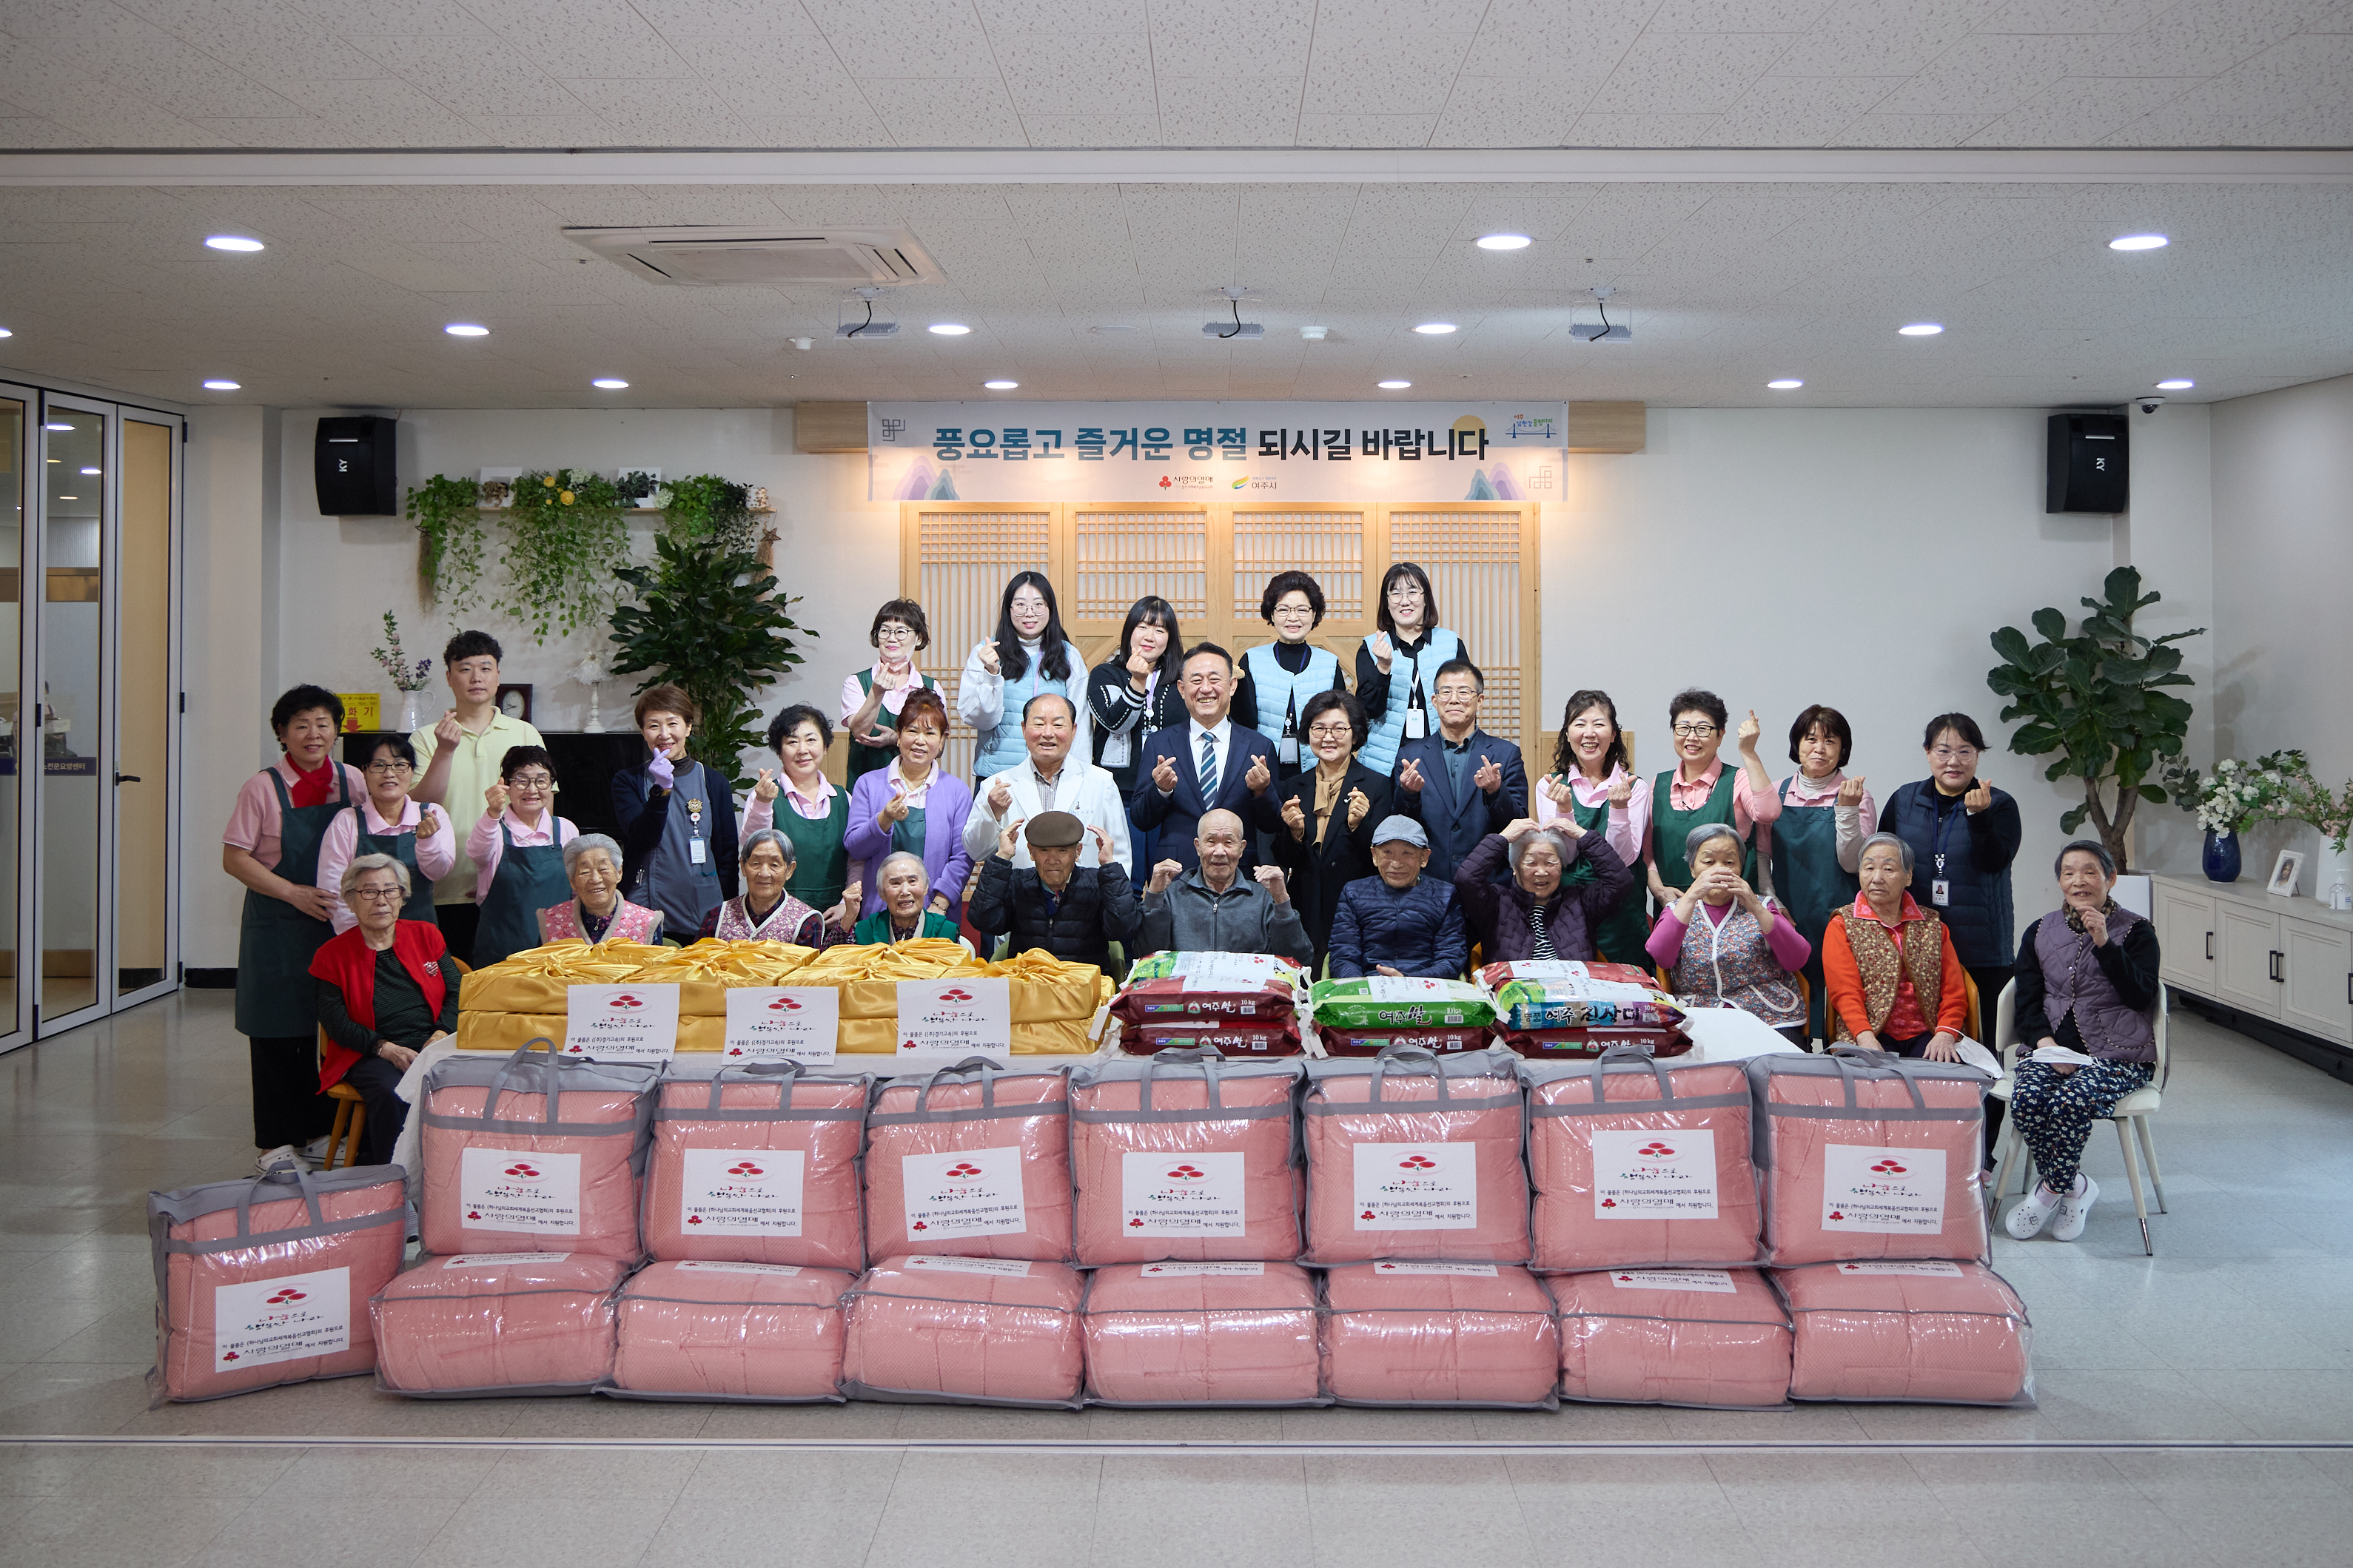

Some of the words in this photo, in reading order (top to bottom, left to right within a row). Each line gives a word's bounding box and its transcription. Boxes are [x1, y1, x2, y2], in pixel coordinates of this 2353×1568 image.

[933, 428, 1064, 460] 풍요롭고
[1075, 428, 1173, 460] 즐거운
[1184, 428, 1246, 461] 명절
[1258, 429, 1351, 461] 되시길
[1362, 429, 1488, 461] 바랍니다
[339, 459, 347, 471] KY
[2096, 458, 2105, 471] KY
[348, 707, 372, 716] 화기
[1202, 1000, 1236, 1013] 여주쌀
[1379, 1004, 1432, 1026] 여주쌀
[1525, 1012, 1540, 1022] 명품
[1545, 1006, 1577, 1026] 여주
[1580, 1006, 1639, 1022] 진상미
[1214, 1036, 1247, 1048] 여주쌀
[1409, 1037, 1442, 1049] 여주쌀
[484, 1213, 536, 1221] 사랑의열매
[930, 1217, 981, 1227] 사랑의열매
[1847, 1213, 1900, 1221] 사랑의열매
[324, 1325, 343, 1333] 후원으로
[243, 1341, 302, 1355] 사랑의열매
[318, 1337, 345, 1346] 지원합니다.
